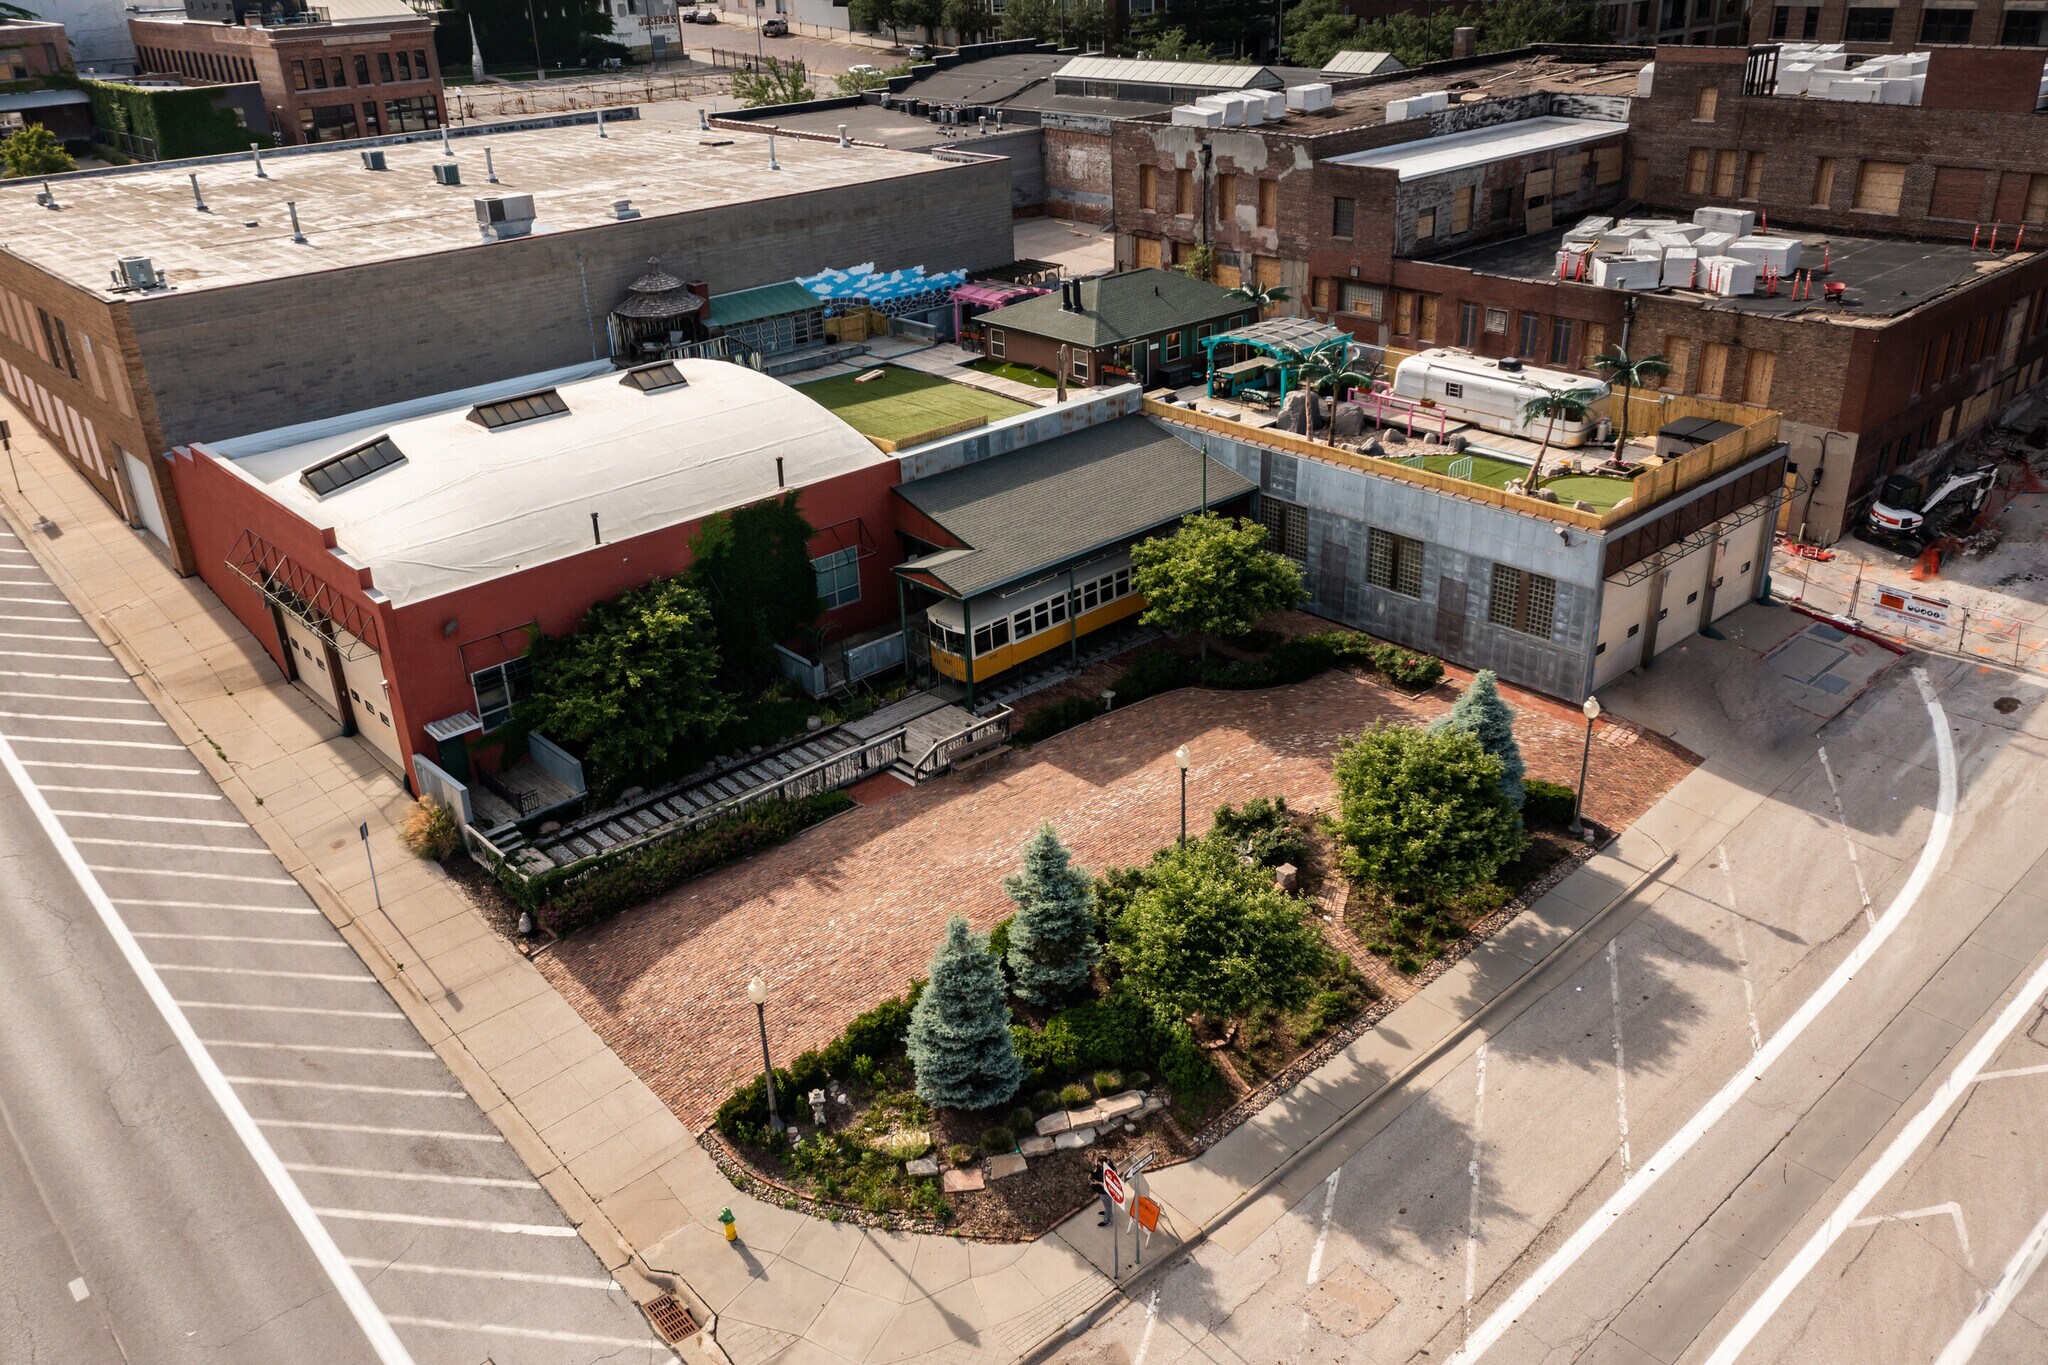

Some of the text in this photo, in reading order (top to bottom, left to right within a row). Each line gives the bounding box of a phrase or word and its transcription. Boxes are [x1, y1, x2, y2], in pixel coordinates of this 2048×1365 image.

[1106, 1170, 1122, 1190] DO NOT
[1107, 1184, 1121, 1201] ENTER
